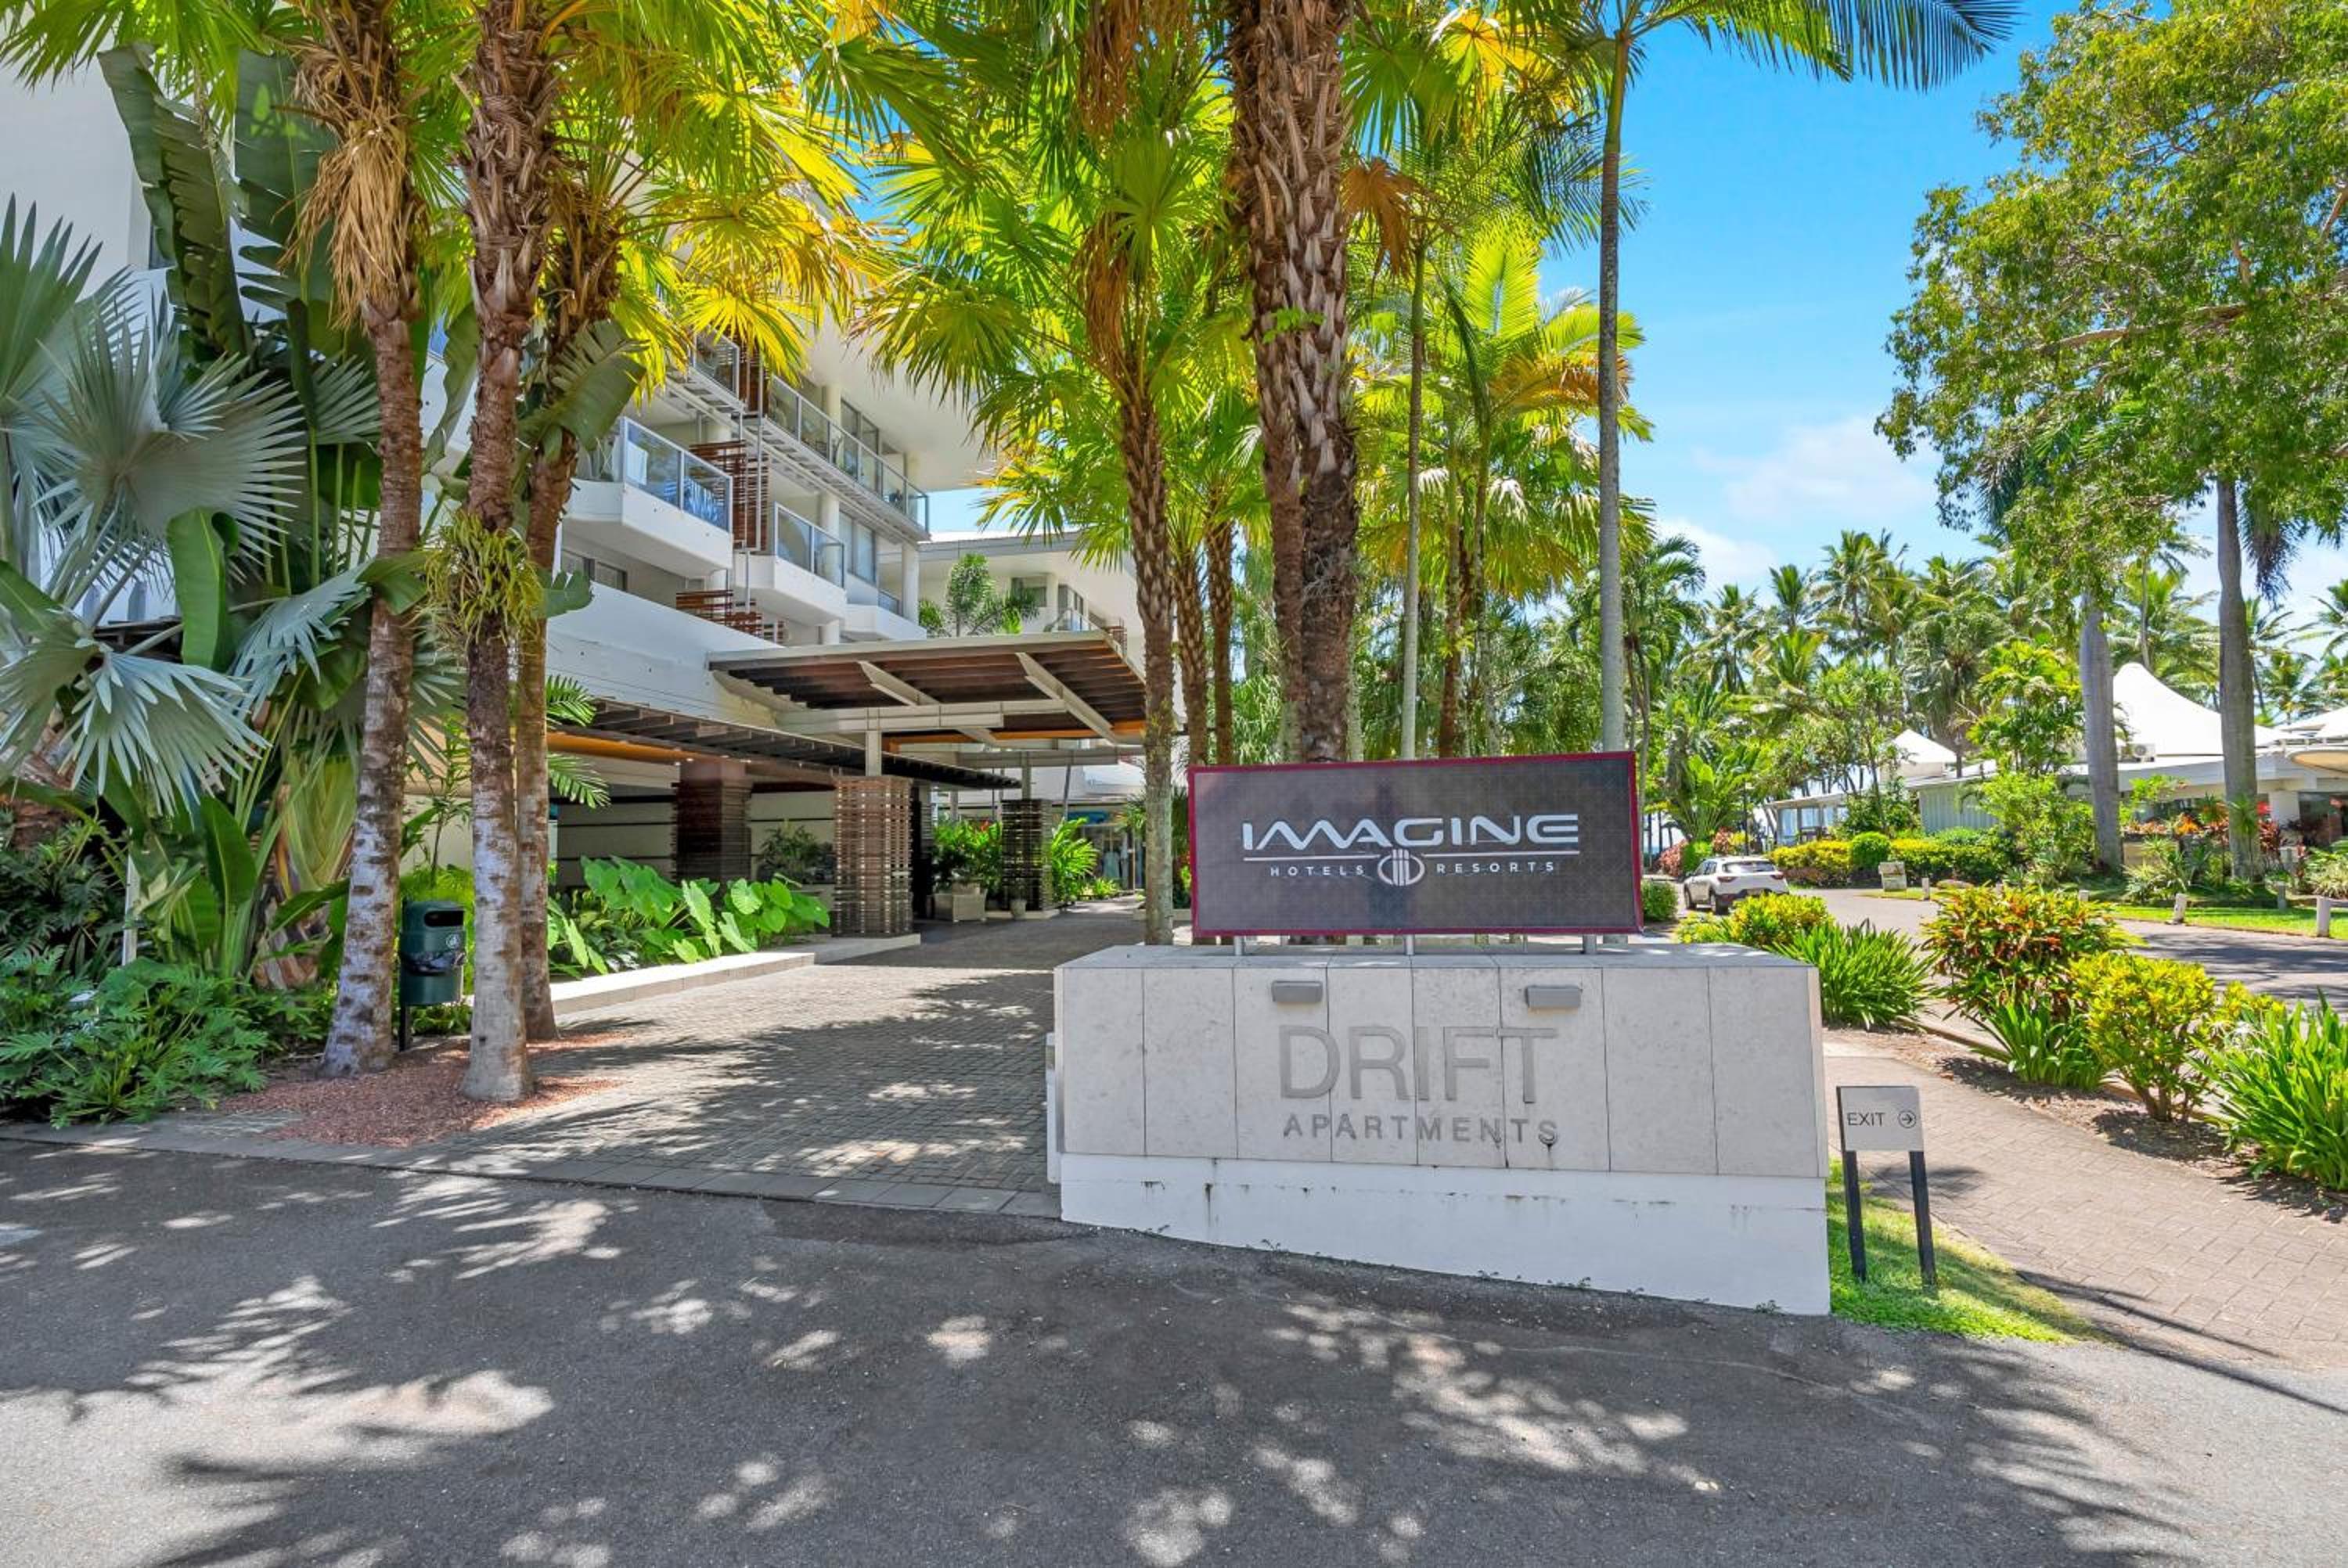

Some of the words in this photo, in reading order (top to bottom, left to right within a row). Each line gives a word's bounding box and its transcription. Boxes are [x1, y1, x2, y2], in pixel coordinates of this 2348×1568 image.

[1242, 814, 1579, 851] IMAGINE
[1270, 864, 1365, 877] HOTELS
[1436, 861, 1554, 874] RESORTS
[1278, 1024, 1558, 1103] DRIFT
[1283, 1113, 1559, 1145] APARTMENTS
[1846, 1112, 1885, 1126] EXIT
